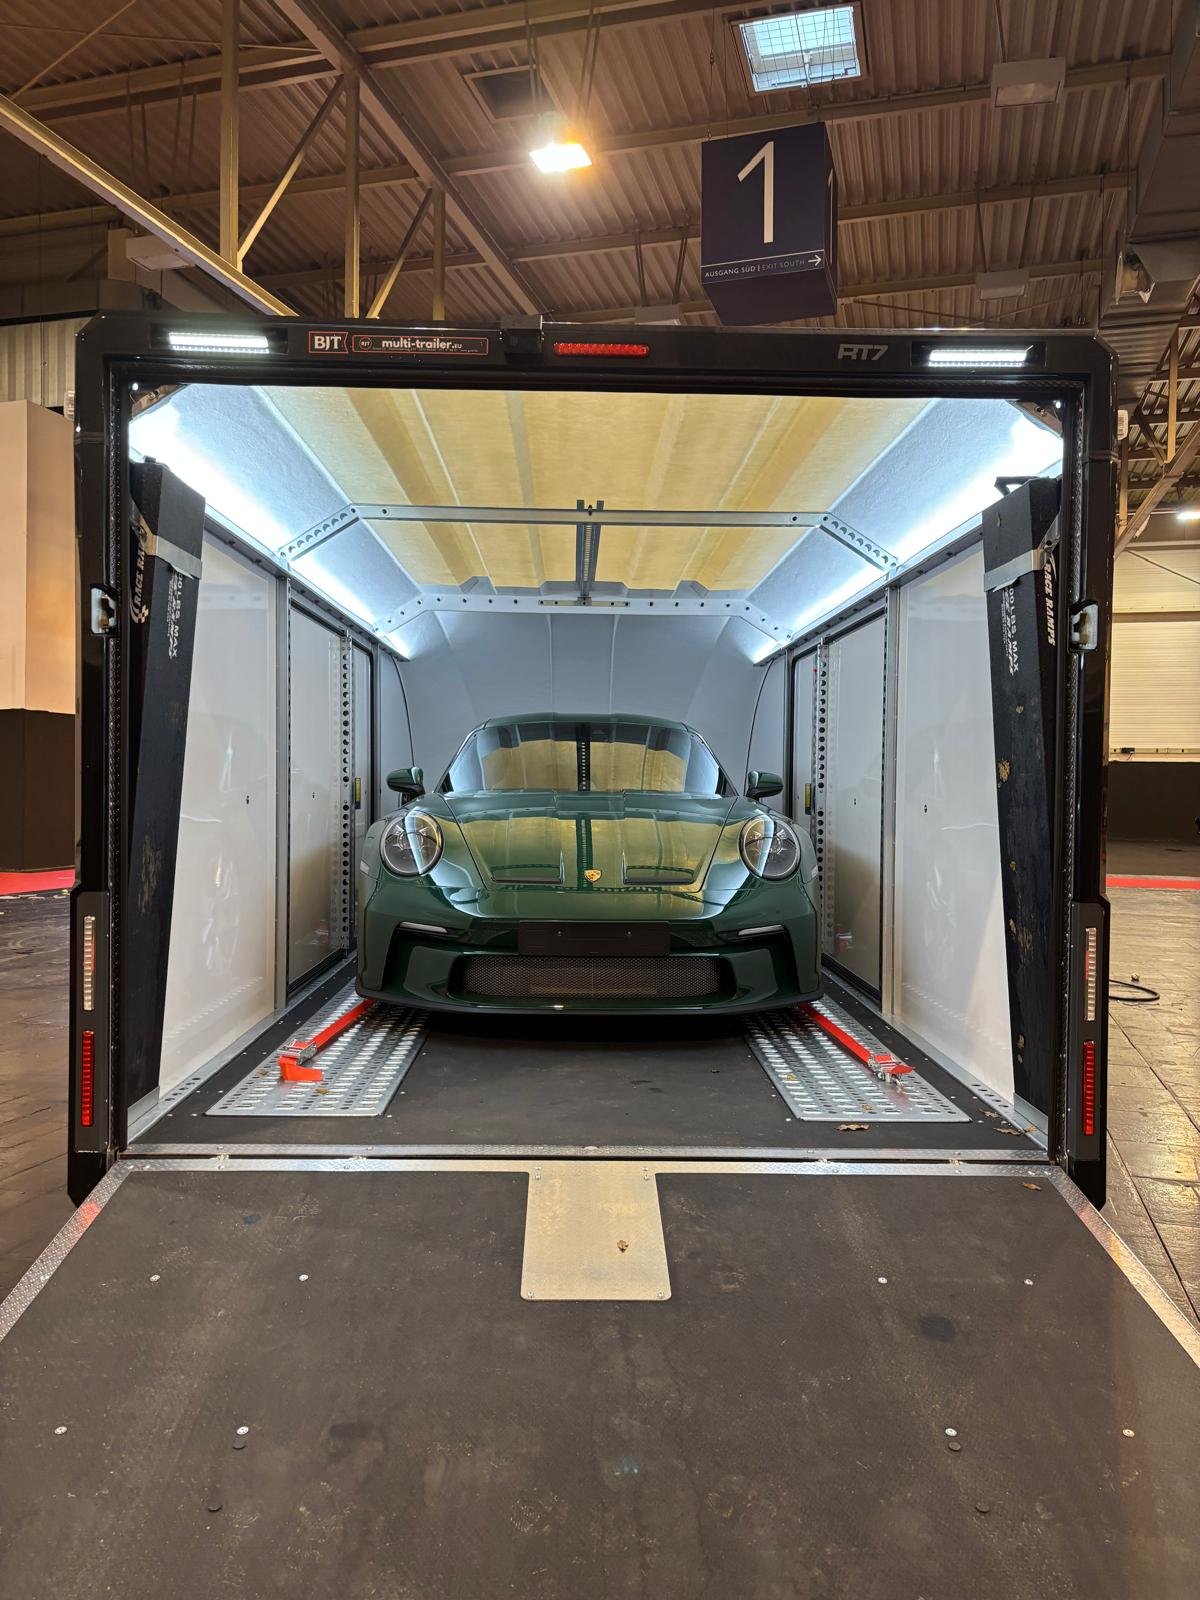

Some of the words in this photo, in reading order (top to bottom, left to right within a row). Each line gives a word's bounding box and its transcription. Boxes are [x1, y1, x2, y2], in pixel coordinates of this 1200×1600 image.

[737, 141, 774, 243] 1
[705, 267, 739, 277] AUSGANG
[741, 264, 756, 273] SÜD
[780, 259, 804, 268] SOUTH
[313, 335, 342, 350] BJT
[838, 344, 888, 360] RT7
[134, 571, 144, 607] RACE
[1044, 563, 1053, 597] RACE
[1045, 597, 1056, 646] RAMPS
